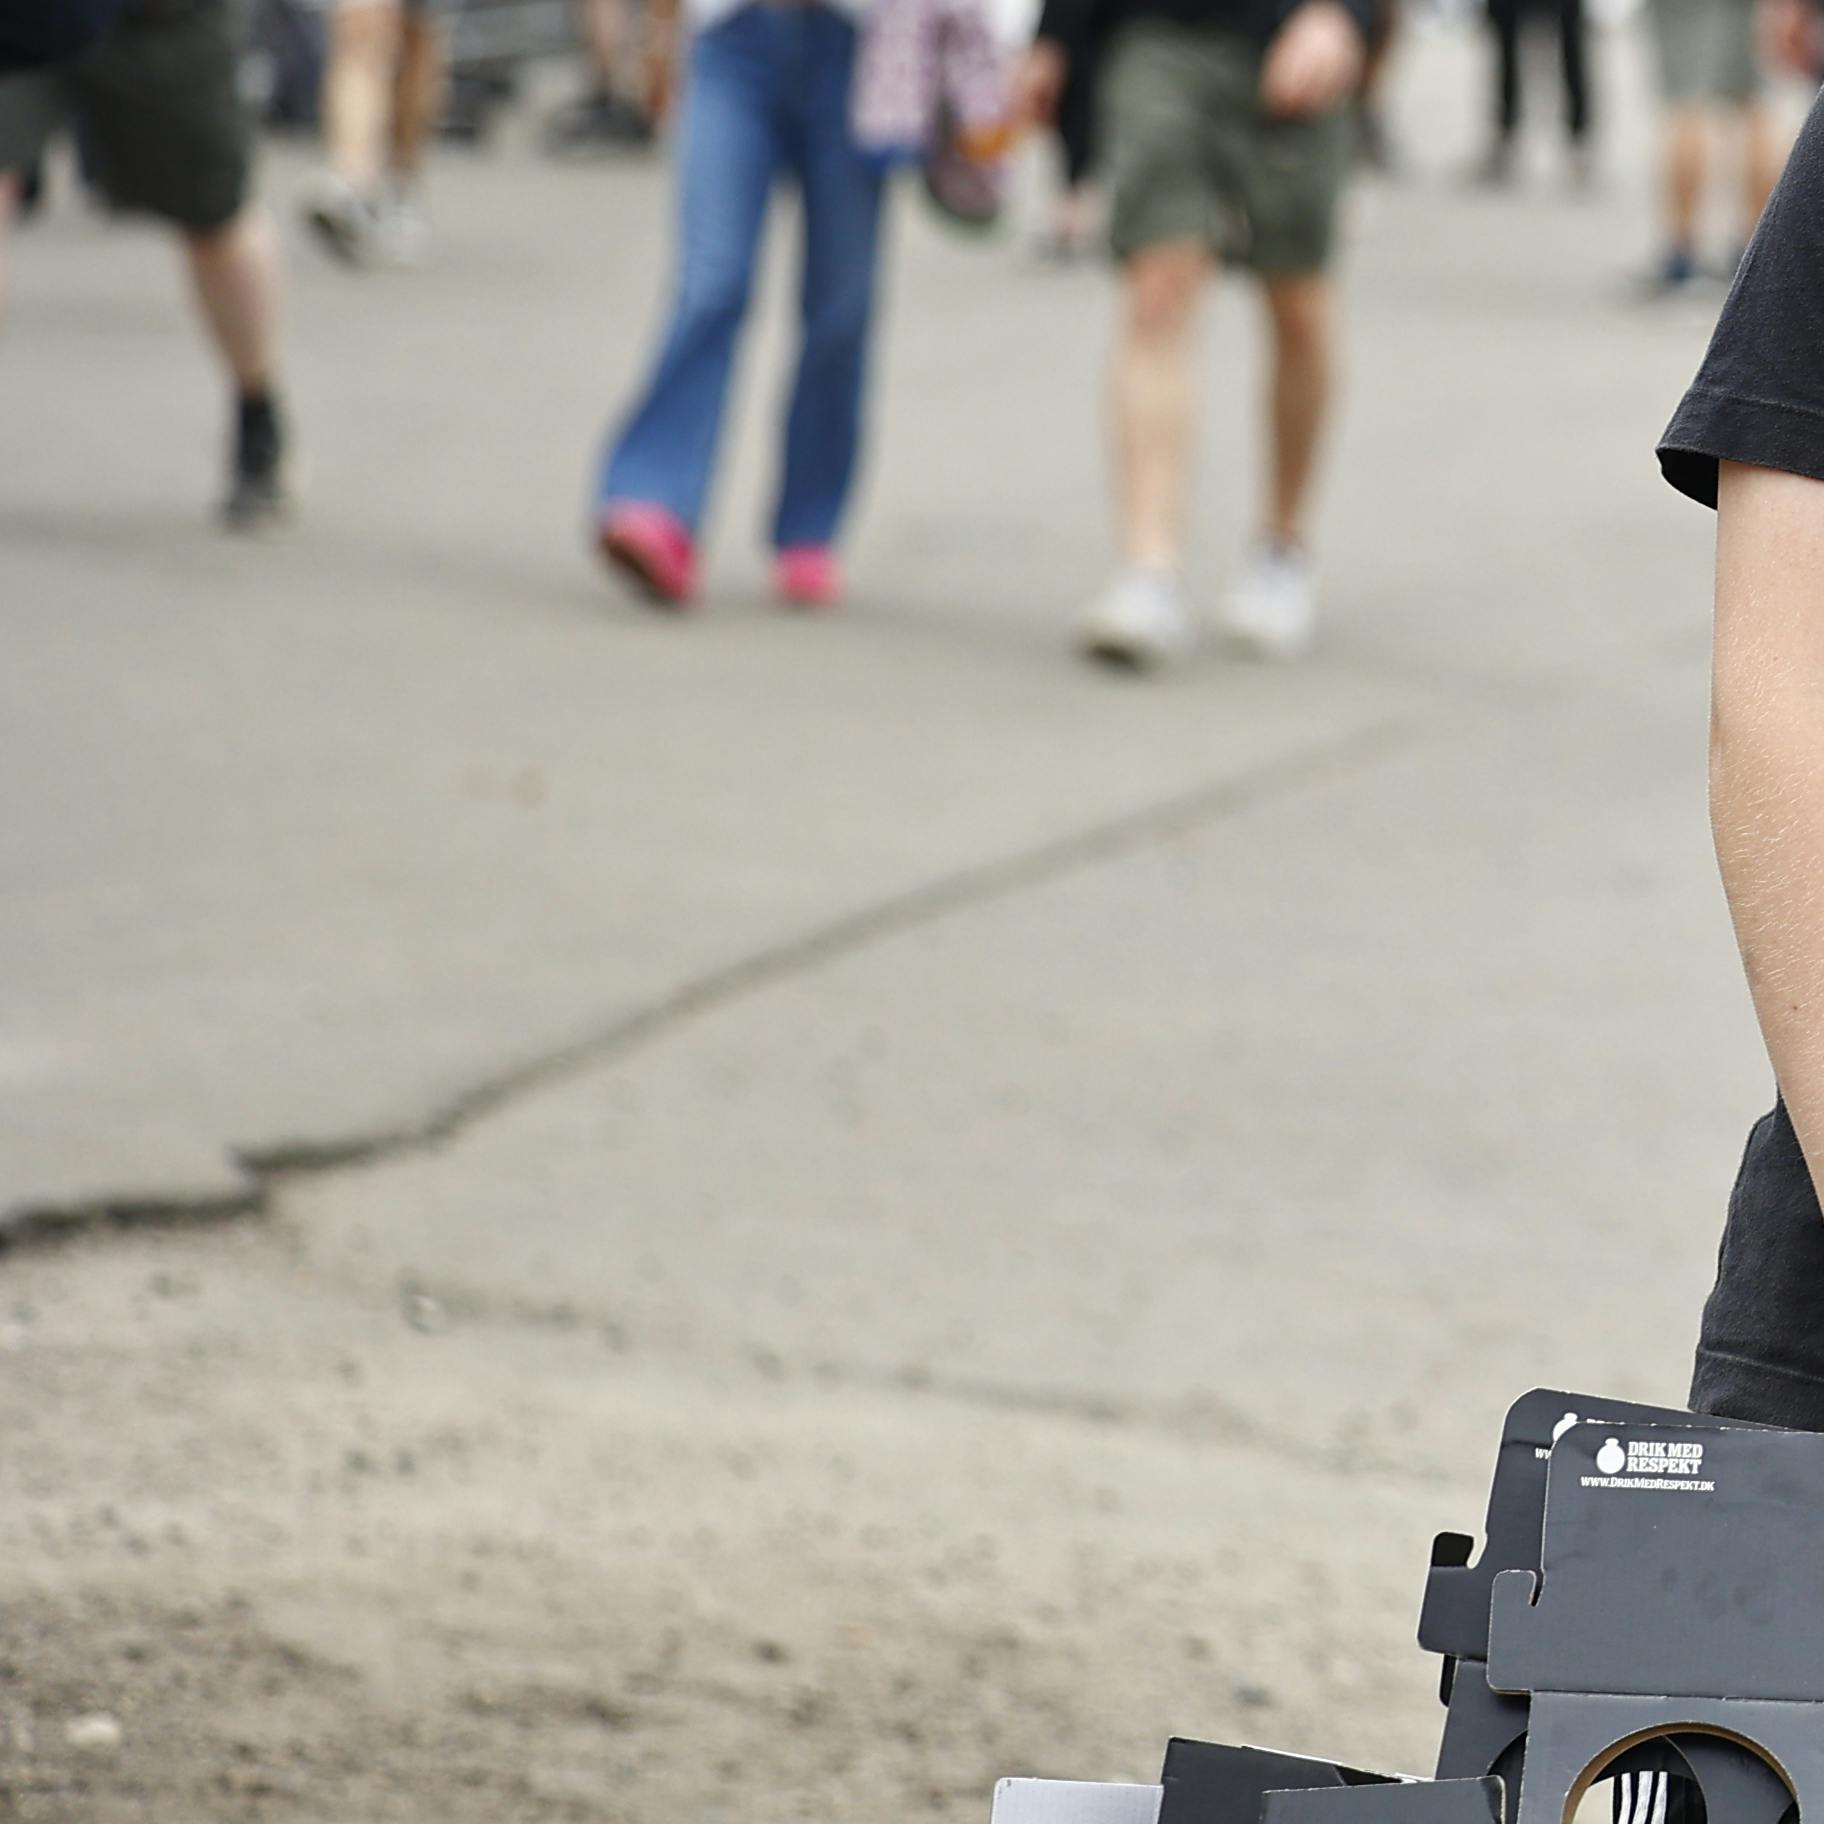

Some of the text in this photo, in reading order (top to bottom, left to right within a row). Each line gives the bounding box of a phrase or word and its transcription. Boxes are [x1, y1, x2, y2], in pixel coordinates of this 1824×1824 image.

[1627, 1441, 1703, 1459] DRIK MED
[1626, 1457, 1702, 1475] RESPEKT
